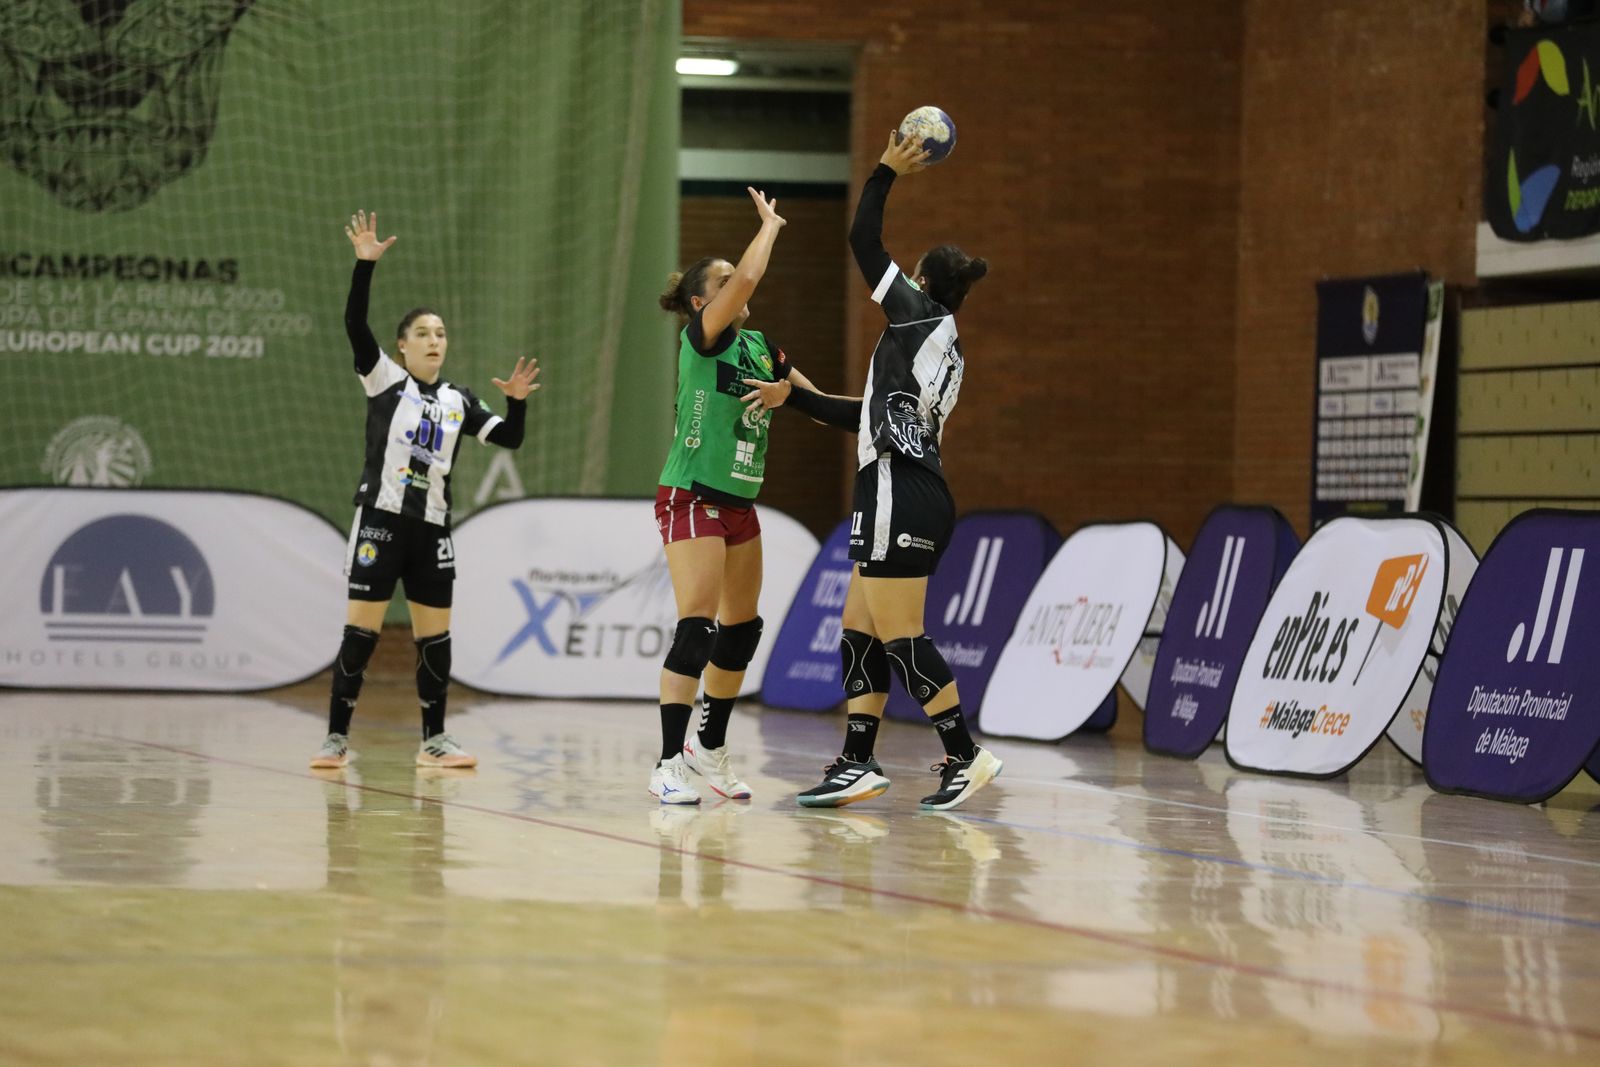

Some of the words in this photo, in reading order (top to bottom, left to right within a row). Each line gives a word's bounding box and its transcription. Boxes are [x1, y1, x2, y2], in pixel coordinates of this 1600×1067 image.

[0, 305, 43, 327] PA
[146, 334, 201, 356] CUP
[205, 334, 265, 358] 2021
[690, 389, 706, 436] SOLIDUS
[360, 529, 393, 542] TORRES
[490, 578, 676, 664] XEITO
[4, 649, 126, 668] HOTELS
[146, 650, 253, 669] GROUP
[1170, 656, 1200, 688] Diputación
[1198, 659, 1225, 689] Provincial
[1259, 699, 1351, 740] #MálagaCrece
[1466, 685, 1521, 720] Diputación
[1517, 688, 1573, 721] Provincial
[1475, 727, 1492, 754] de
[1487, 726, 1530, 765] Málaga
